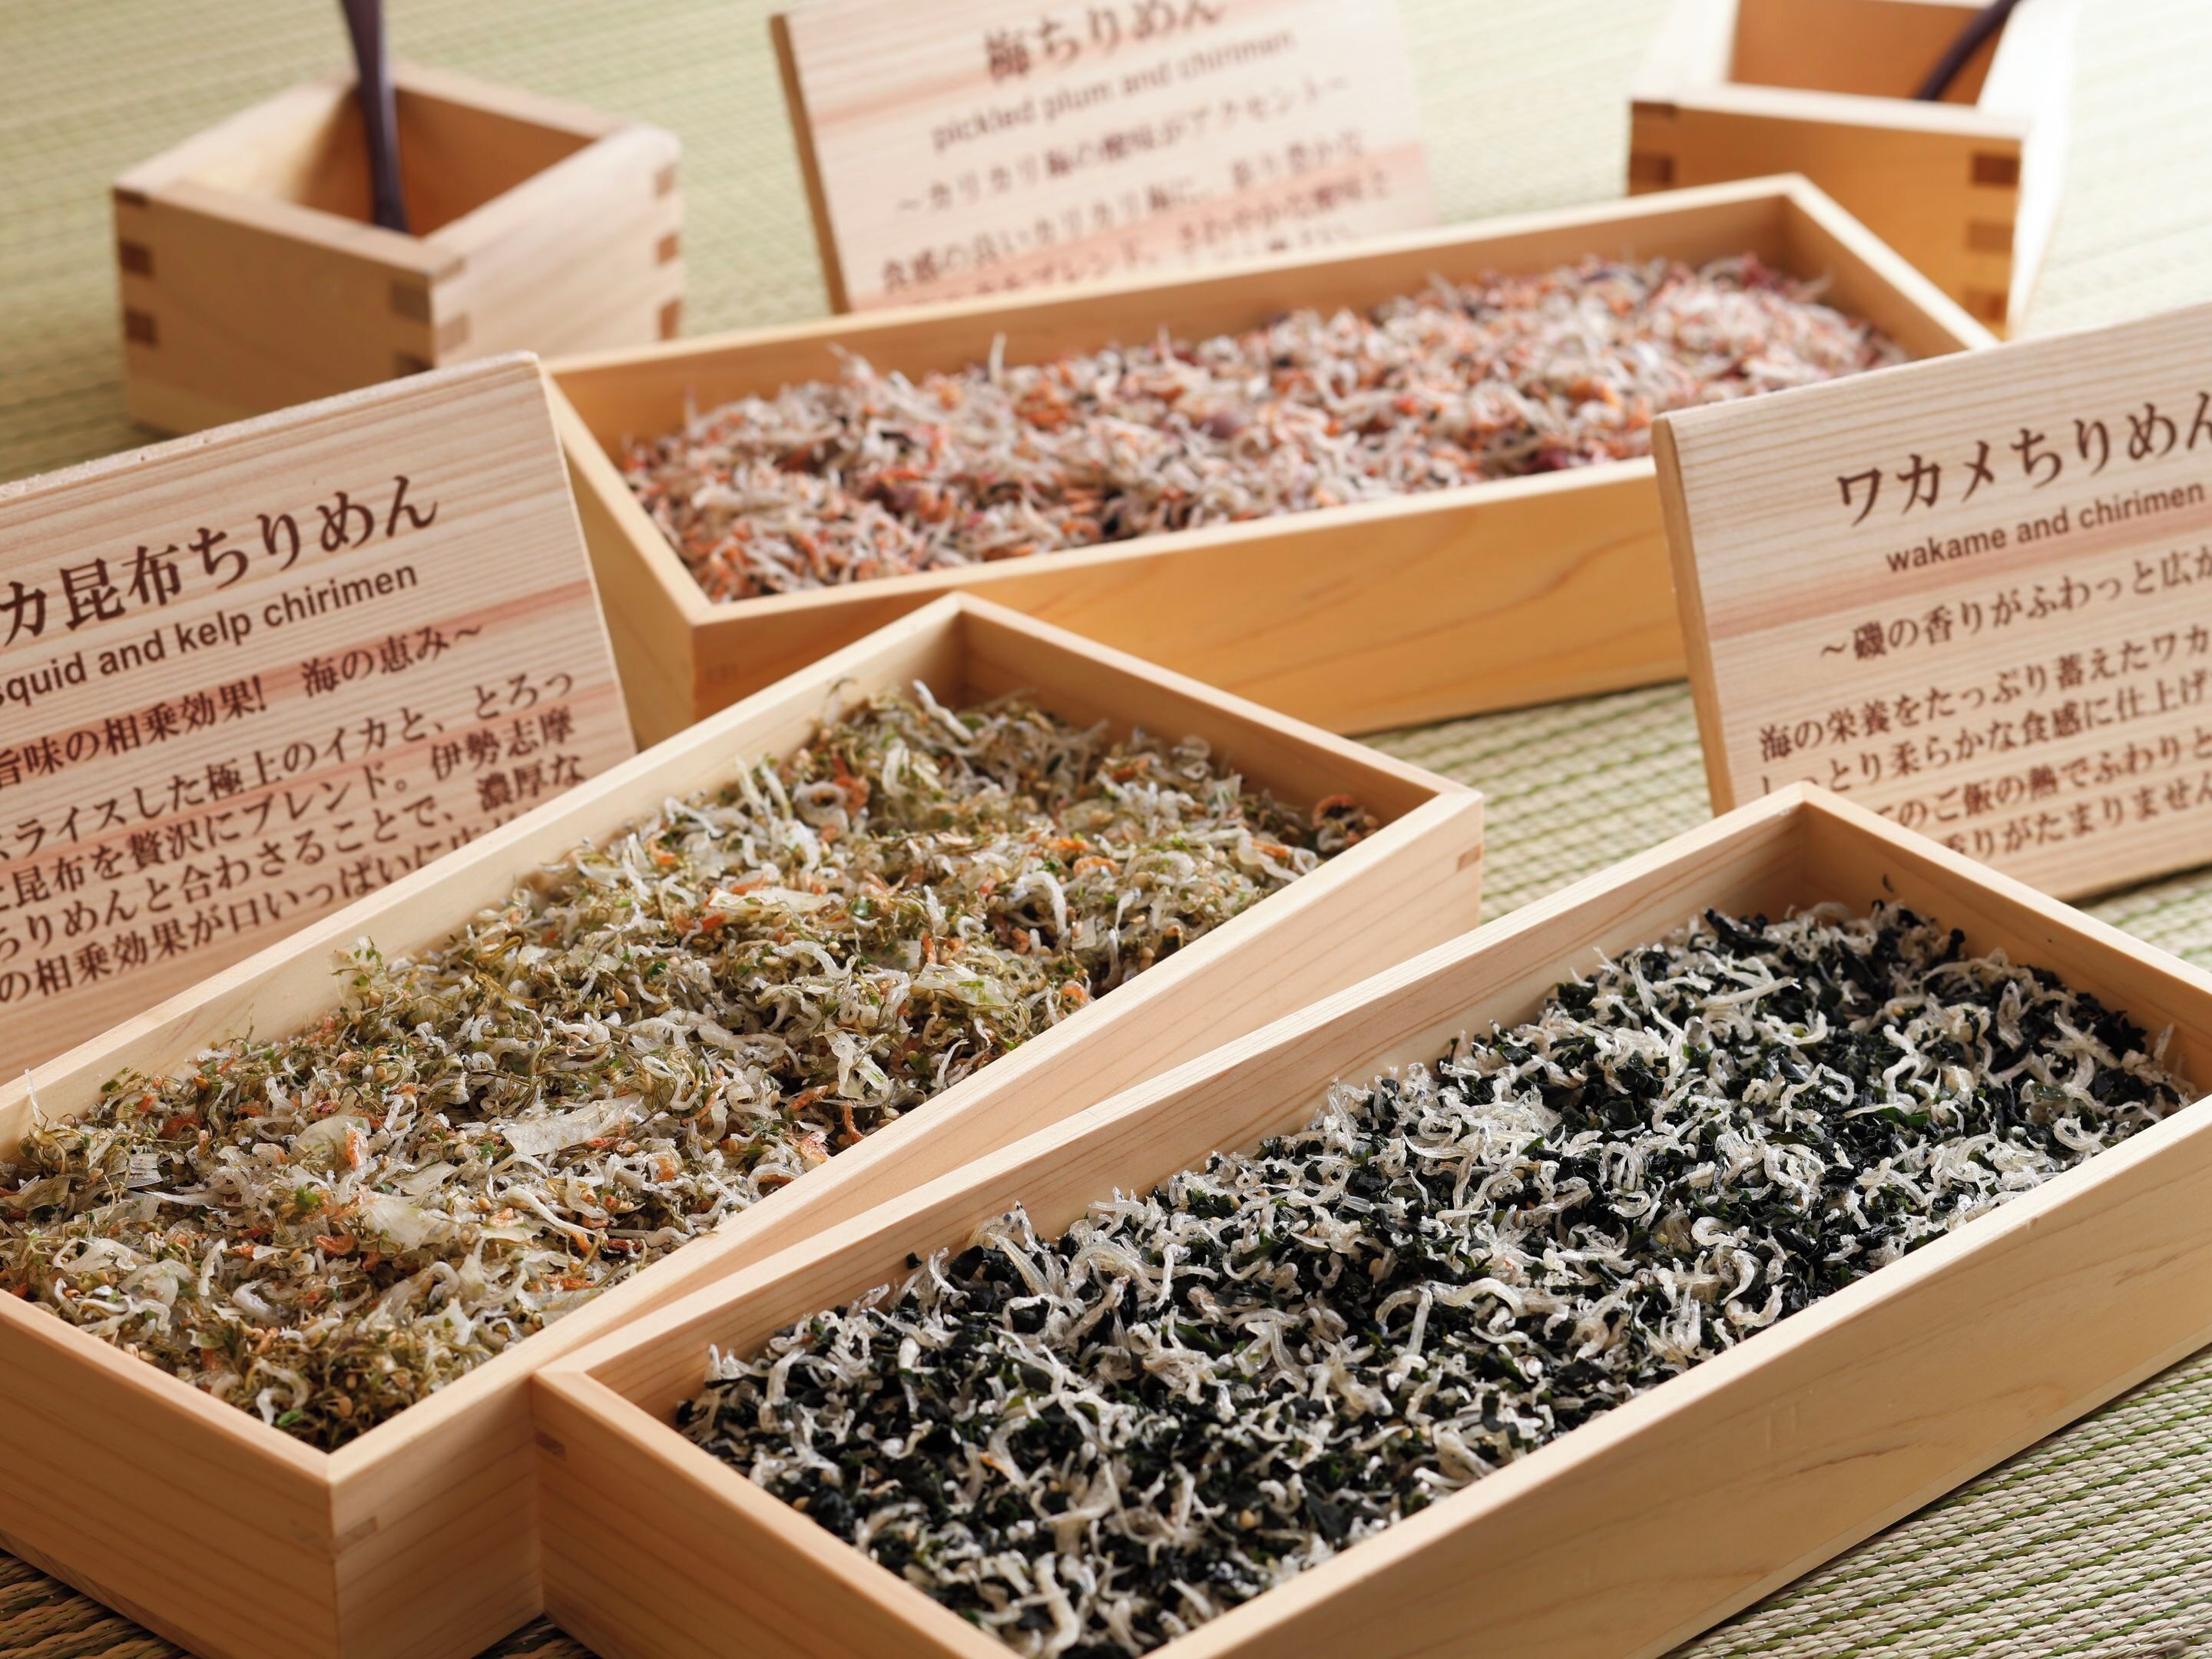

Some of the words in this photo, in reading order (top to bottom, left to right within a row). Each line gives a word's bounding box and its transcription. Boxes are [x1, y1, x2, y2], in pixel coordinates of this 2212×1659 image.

[931, 95, 1035, 154] pickled
[1042, 81, 1111, 121] plum
[1123, 61, 1171, 95] and
[1177, 31, 1294, 78] chirimen
[0, 475, 438, 647] カ昆布ちりめん
[1886, 528, 2007, 572] wakame
[2016, 506, 2070, 543] and
[2078, 482, 2205, 530] chirimen
[0, 652, 87, 707] quid
[98, 630, 166, 676] and
[175, 611, 251, 654] kelp
[263, 565, 418, 627] chirimen
[0, 673, 574, 860] ライスした極上のイカと、とろっ
[1761, 668, 2210, 795] とり柔らかな食感に仕上げ
[0, 706, 575, 912] 昆布を贅沢にブレンド。伊勢志摩
